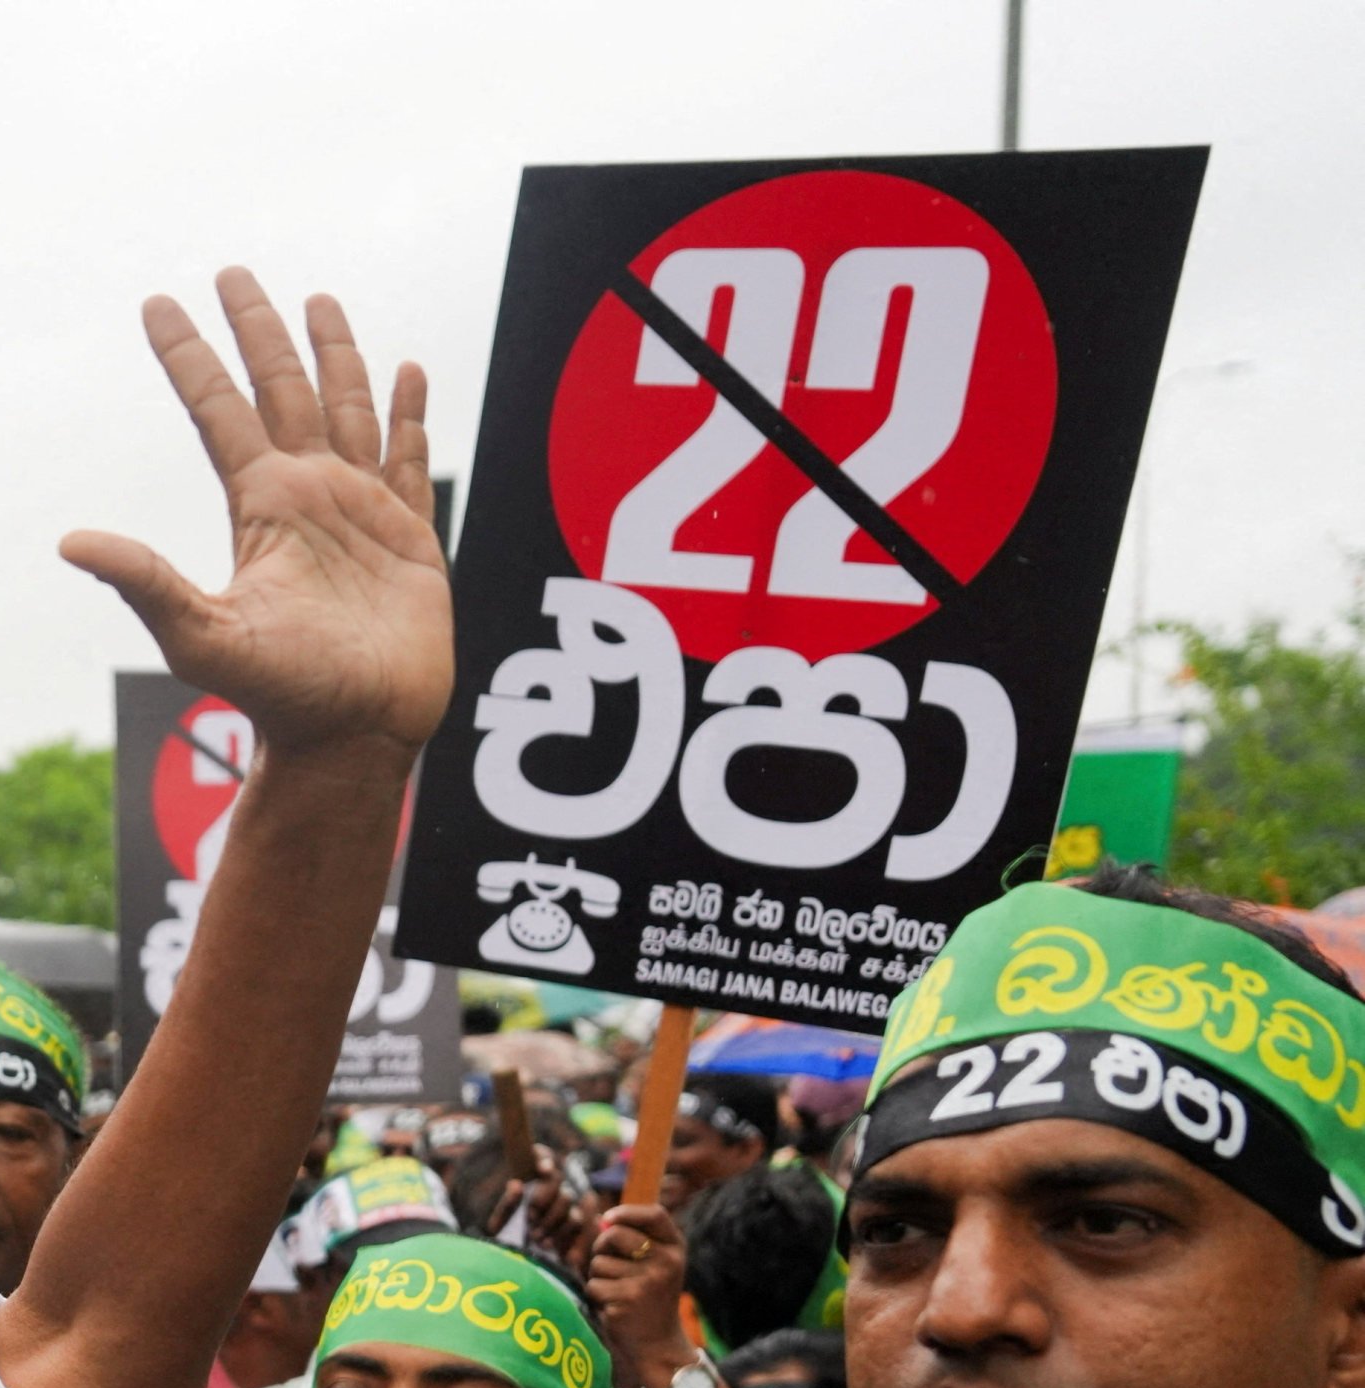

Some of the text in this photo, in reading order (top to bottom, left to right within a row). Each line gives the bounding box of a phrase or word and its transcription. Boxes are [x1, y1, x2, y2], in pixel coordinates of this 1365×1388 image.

[602, 246, 990, 606] 22
[473, 576, 1018, 882] එපා
[649, 880, 724, 923] සමගි
[733, 888, 784, 931] ජන
[635, 957, 719, 992] SAMAGI
[720, 970, 775, 1001] JANA
[930, 1032, 1247, 1159] 22 එපා
